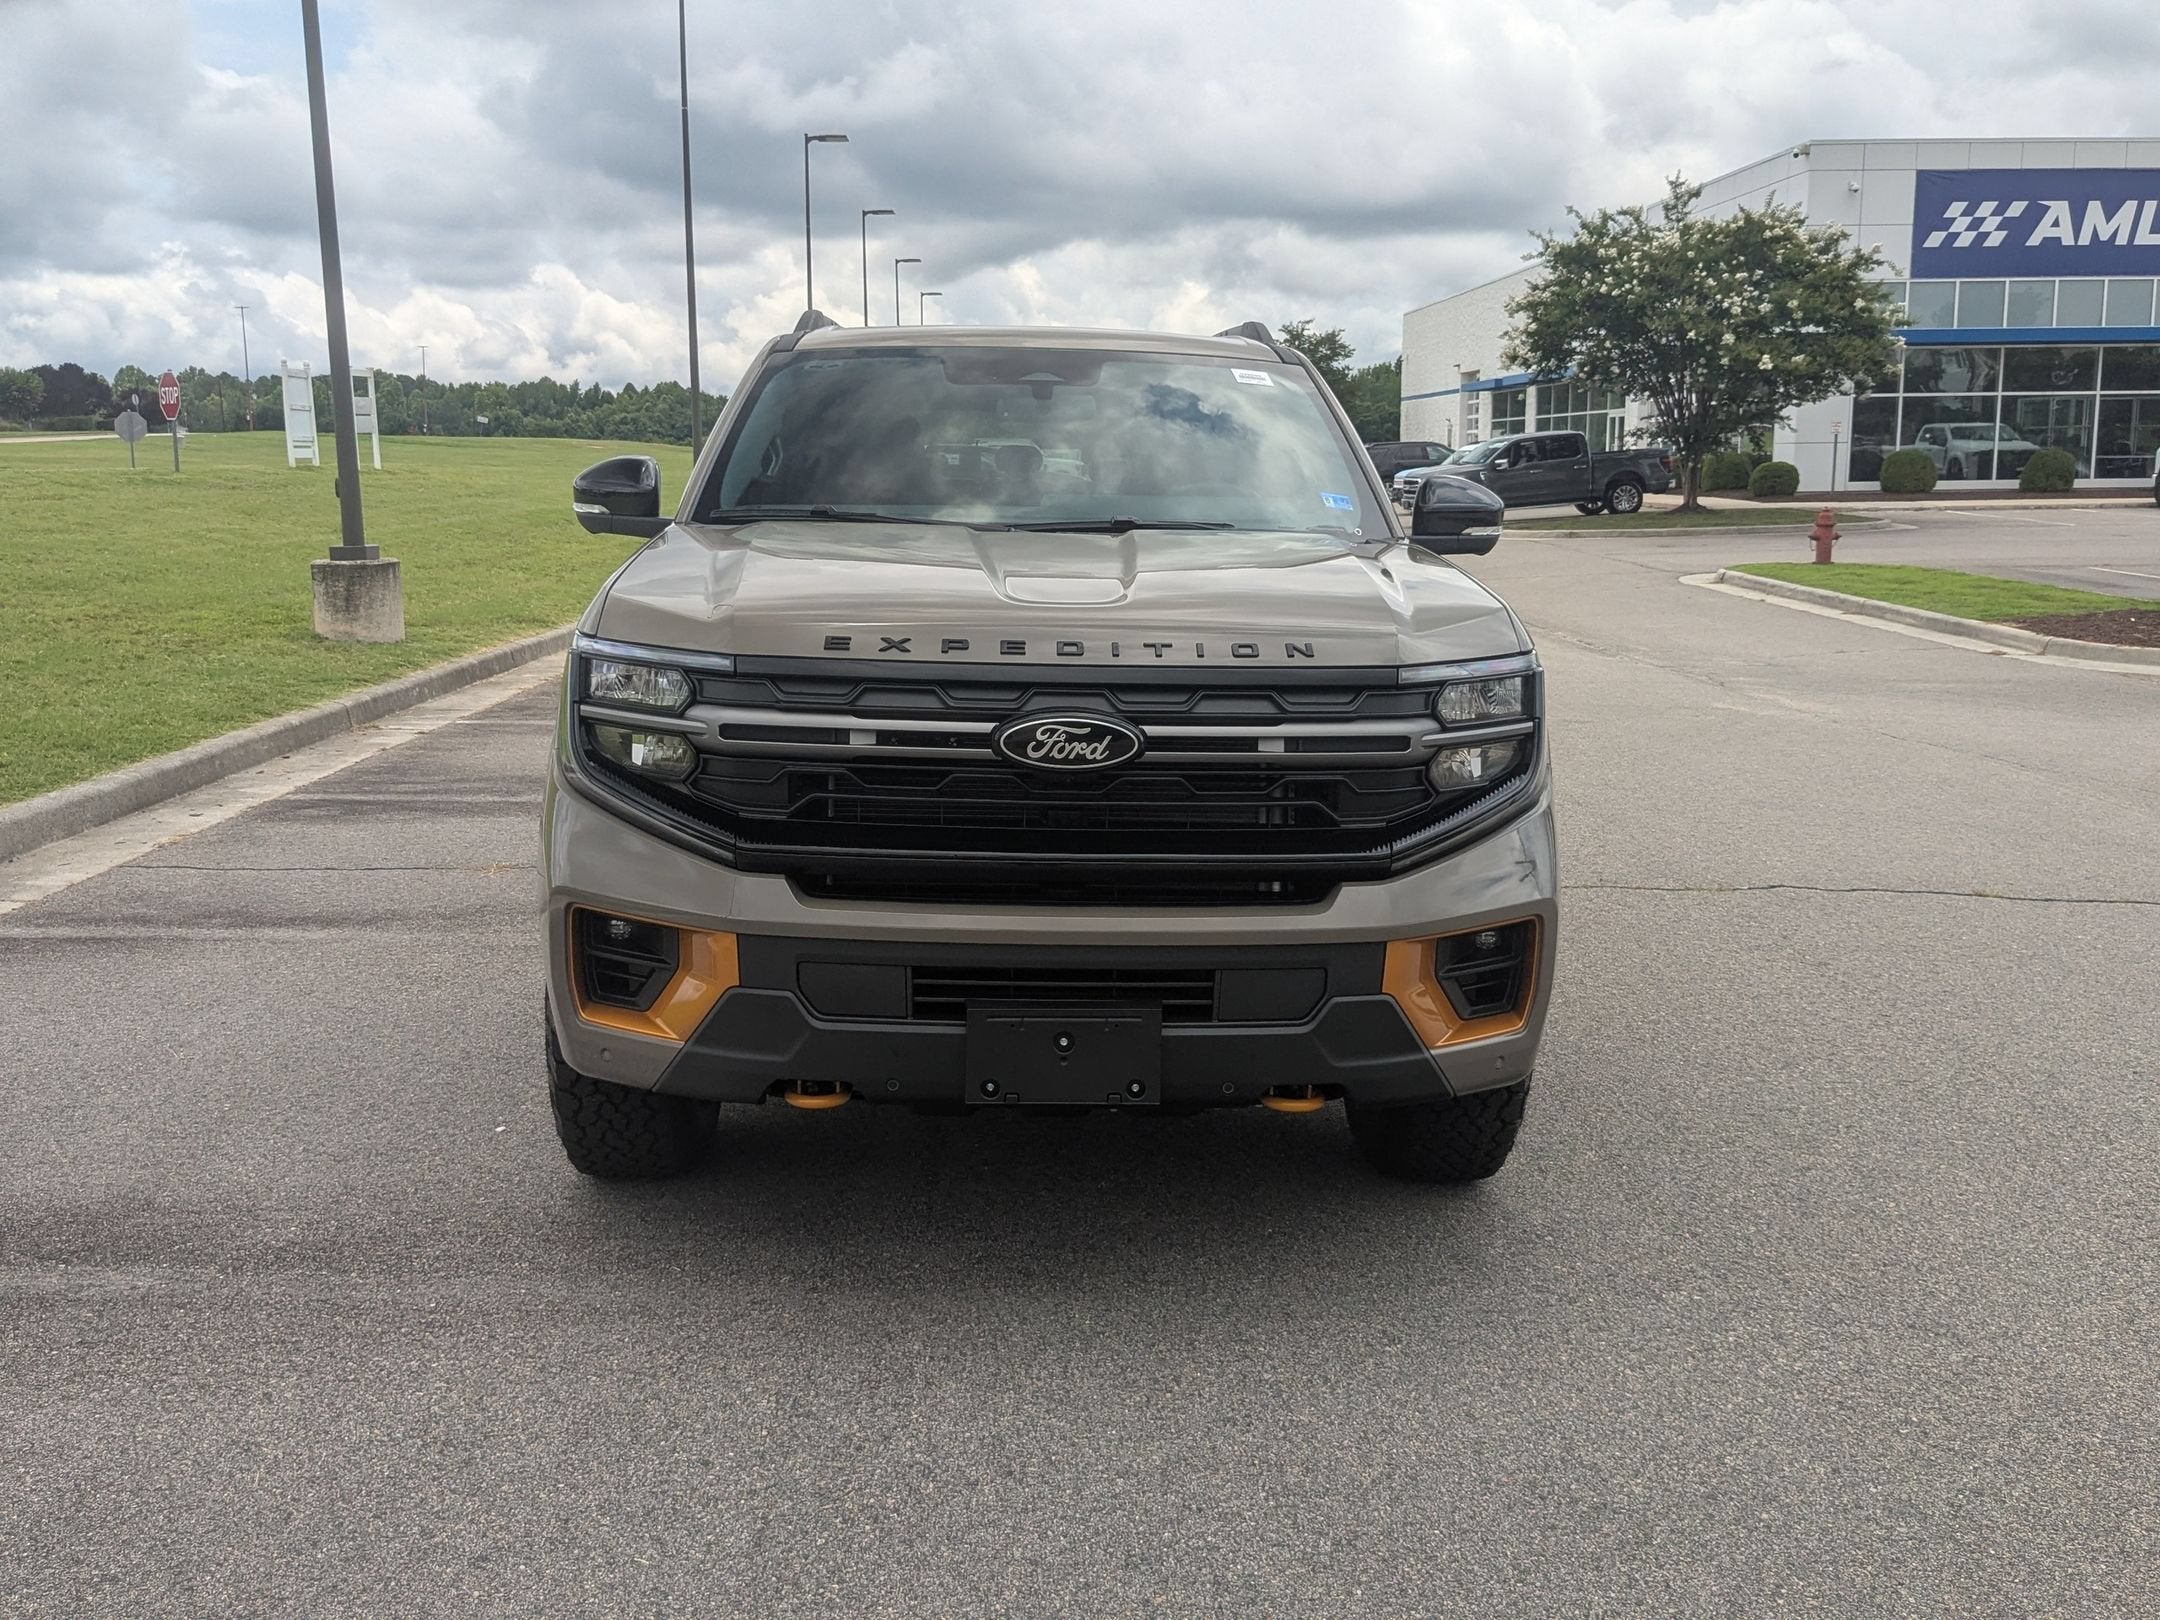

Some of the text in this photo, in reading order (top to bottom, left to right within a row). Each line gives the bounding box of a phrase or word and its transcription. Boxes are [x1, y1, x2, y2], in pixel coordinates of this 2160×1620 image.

[161, 387, 179, 405] STOP
[823, 635, 1315, 659] EXPEDITION
[1026, 725, 1112, 760] Ford
